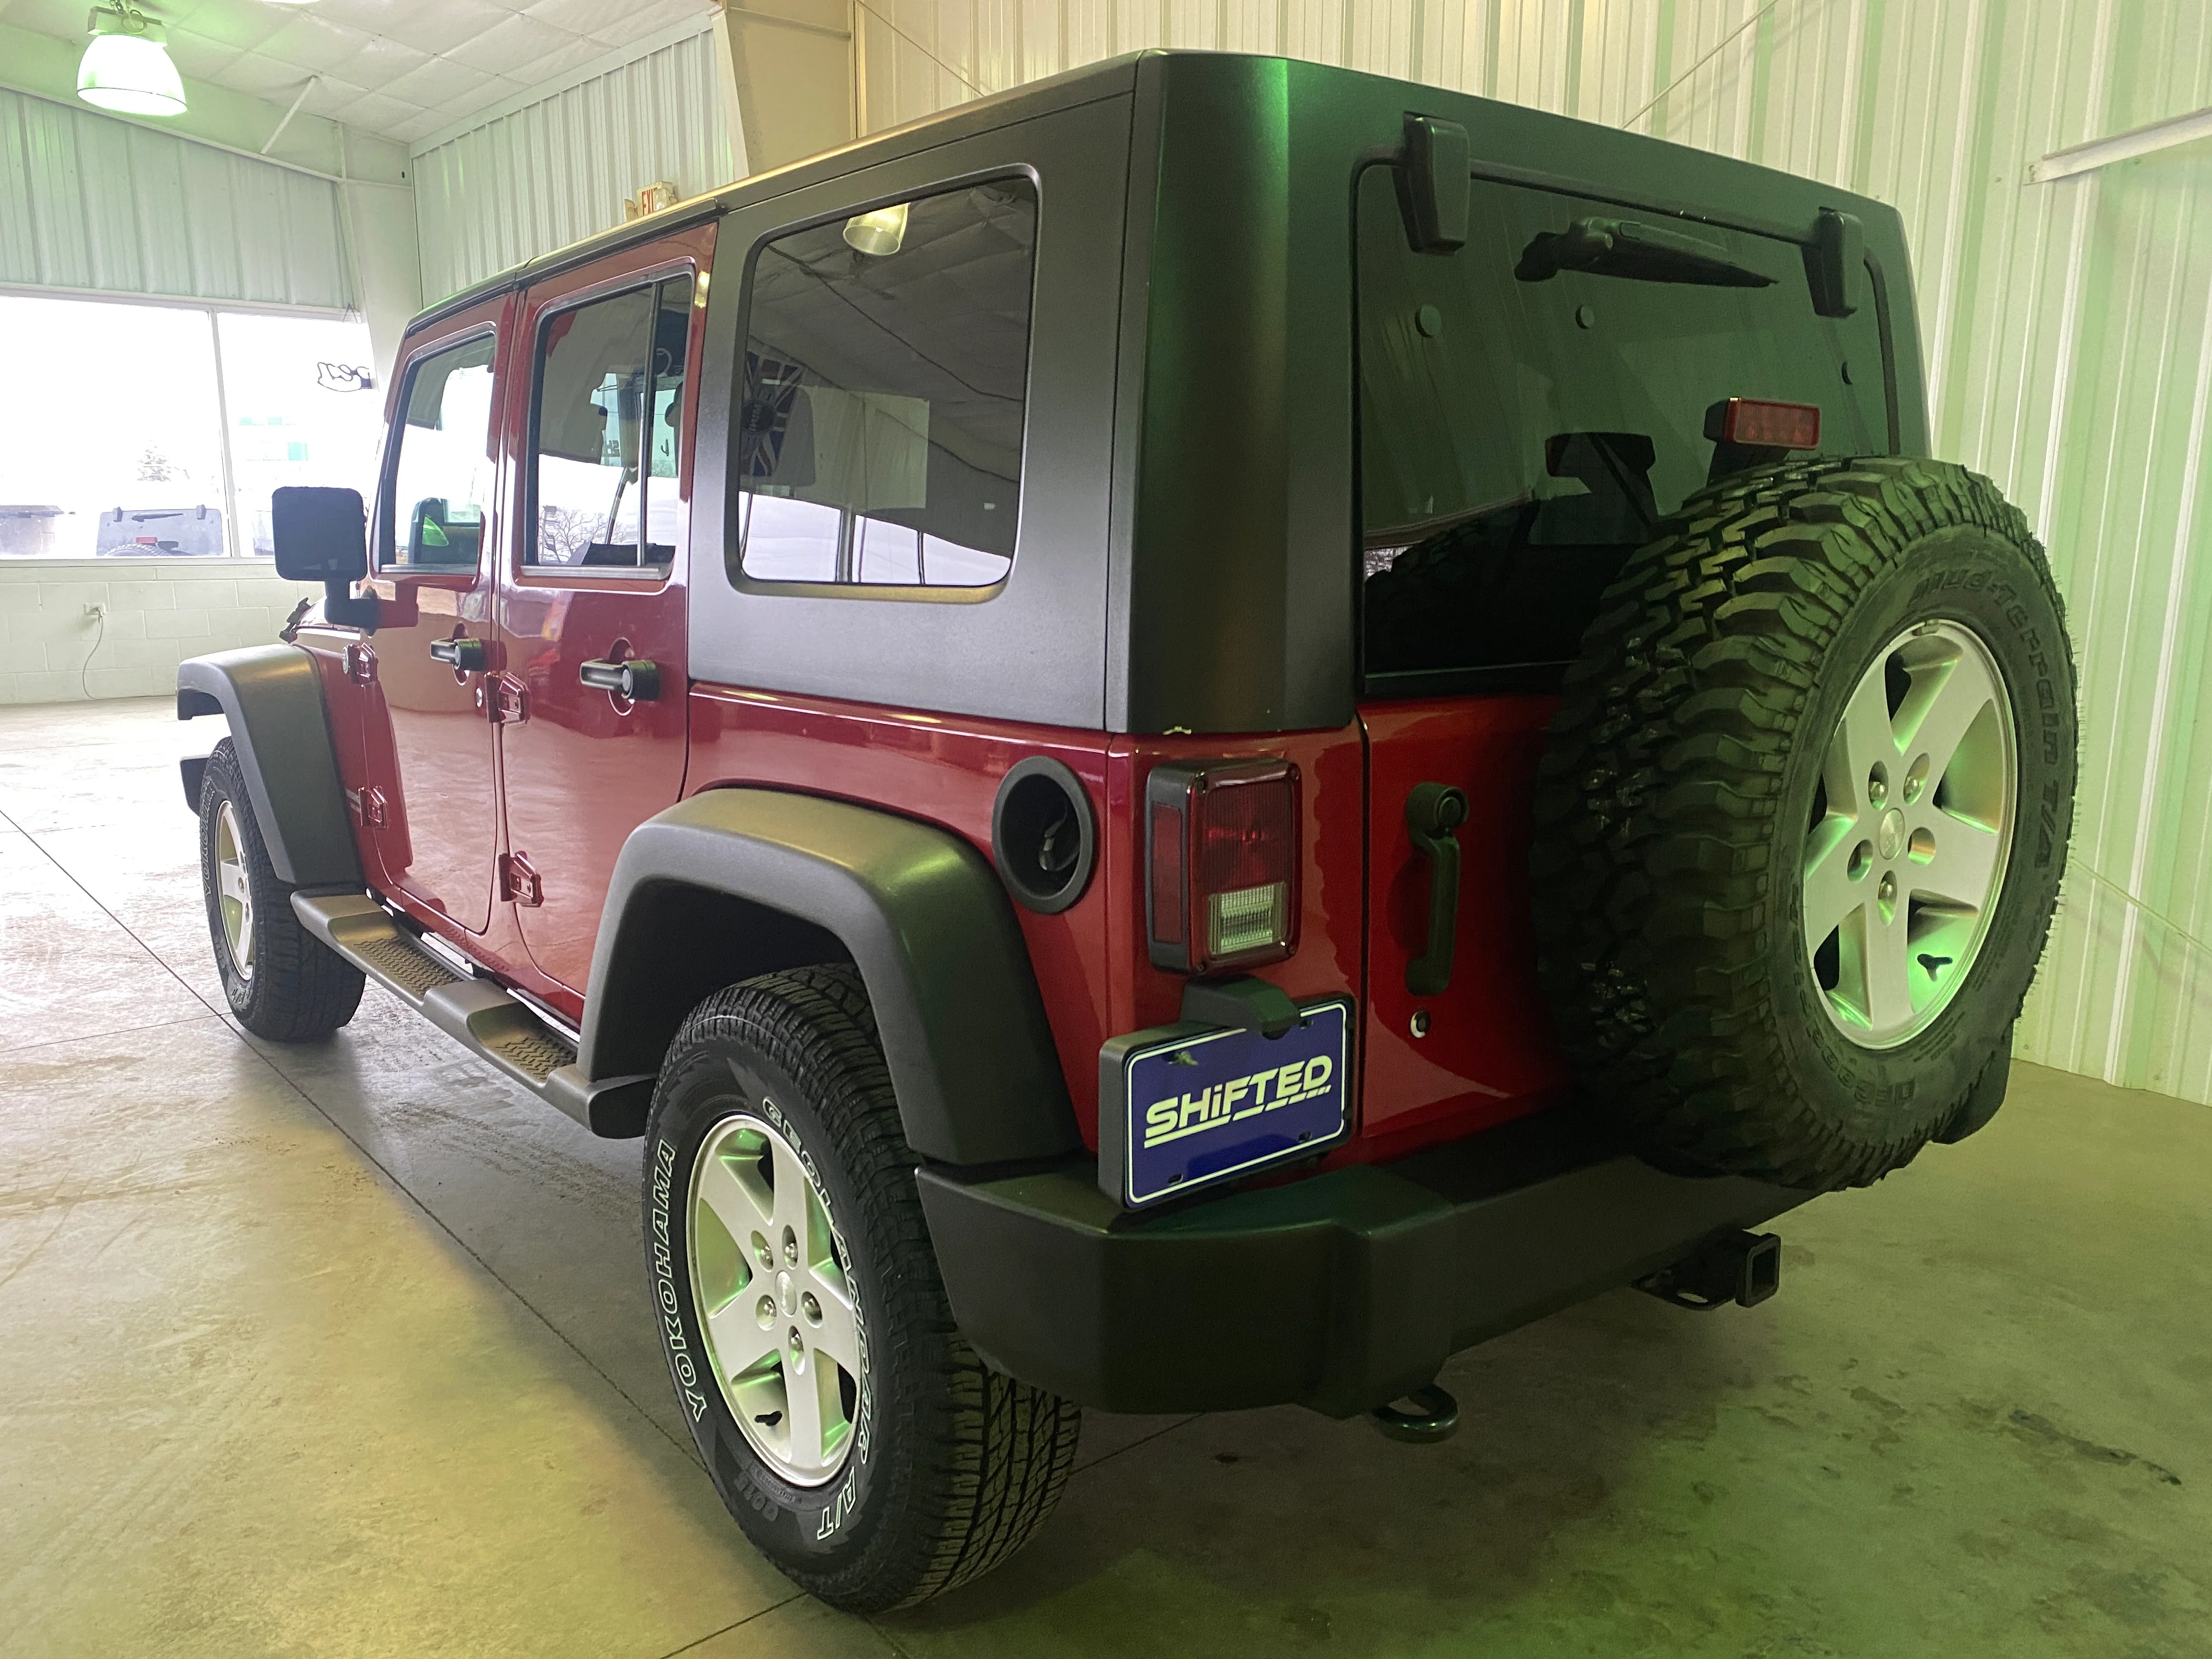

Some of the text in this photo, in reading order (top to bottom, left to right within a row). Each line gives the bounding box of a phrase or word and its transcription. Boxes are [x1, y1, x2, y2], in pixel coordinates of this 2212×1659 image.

[641, 187, 658, 216] EXI
[200, 781, 216, 895] YOKOHAMA
[2035, 779, 2059, 868] T/A
[652, 1139, 709, 1422] YOKOHAMA
[816, 1466, 856, 1541] A/T
